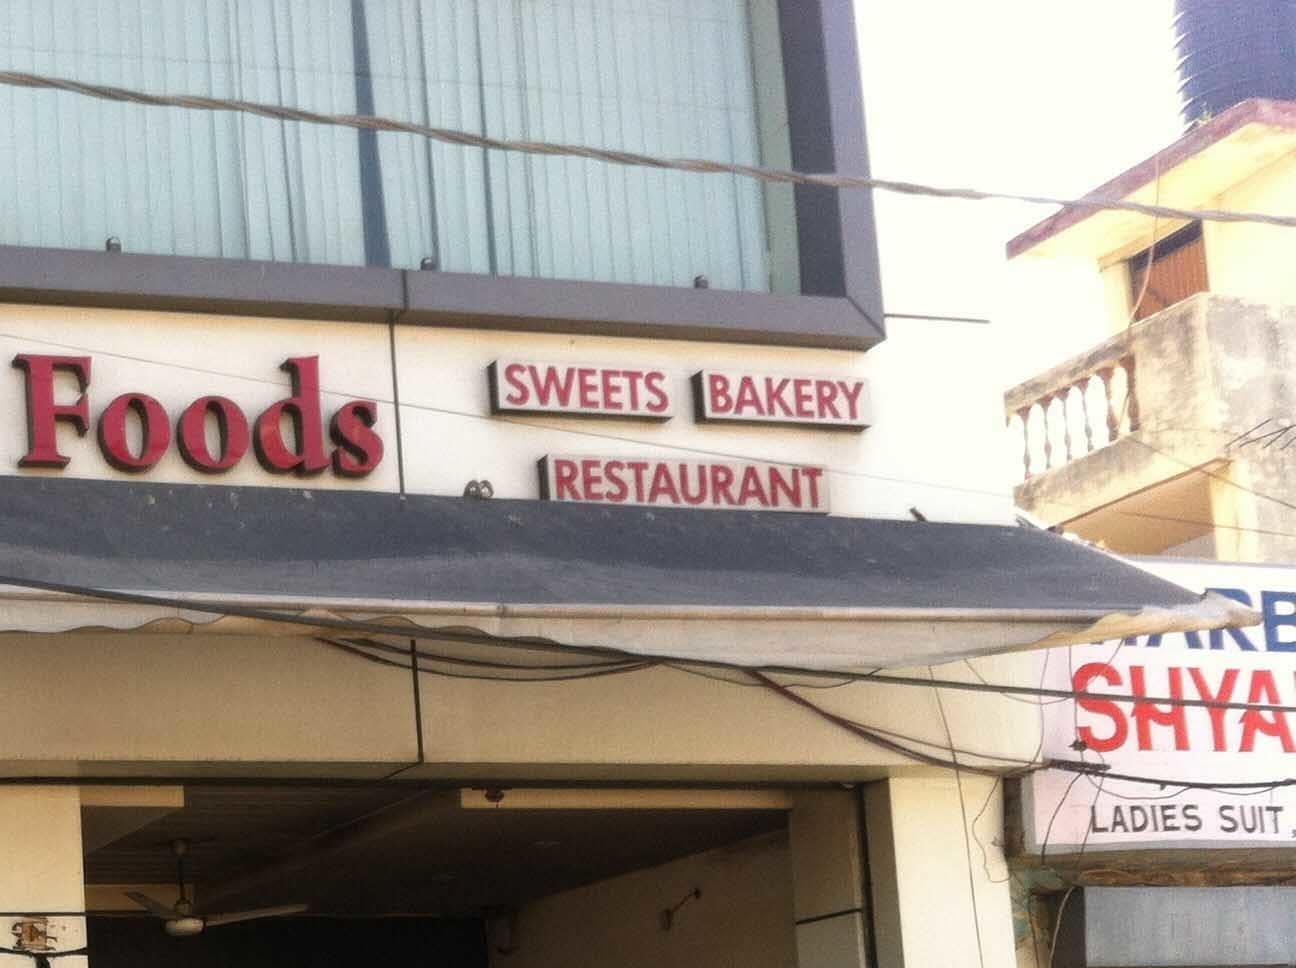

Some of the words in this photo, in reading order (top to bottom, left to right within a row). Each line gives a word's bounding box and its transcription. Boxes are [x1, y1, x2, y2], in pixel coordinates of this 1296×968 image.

[12, 354, 385, 478] Foods
[503, 363, 670, 413] SWEETS
[709, 373, 864, 421] BAKERY
[554, 459, 823, 508] RESTAURANT
[1072, 662, 1296, 752] SHYA
[1091, 804, 1202, 834] LADIES
